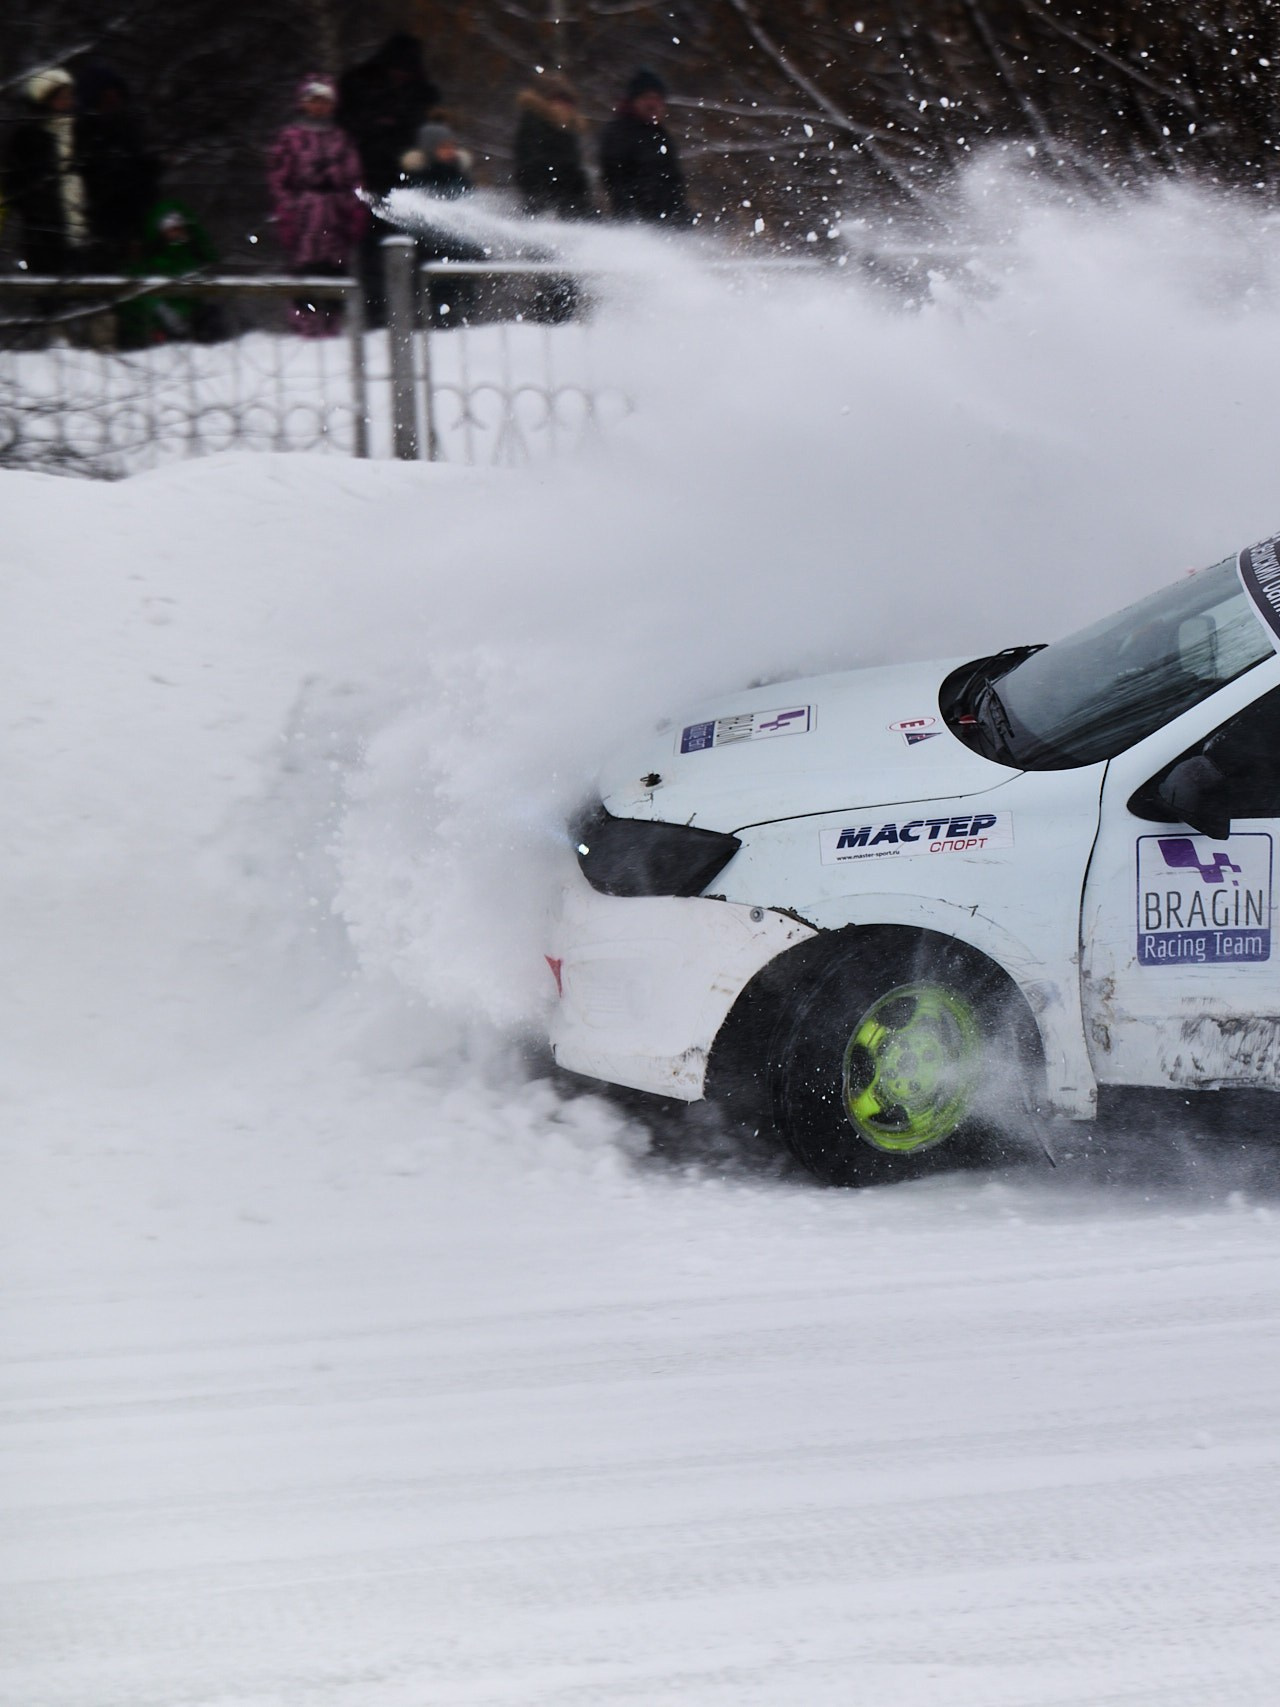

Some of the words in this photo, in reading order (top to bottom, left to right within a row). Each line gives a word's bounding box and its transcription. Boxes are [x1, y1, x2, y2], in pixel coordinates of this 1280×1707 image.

[836, 813, 997, 849] МАСТЕР
[929, 837, 988, 853] СПОРТ
[836, 850, 900, 861] www.master-sport.ru
[1145, 889, 1263, 930] BRAGIN
[1144, 934, 1206, 962] Racing
[1213, 931, 1262, 956] Team
